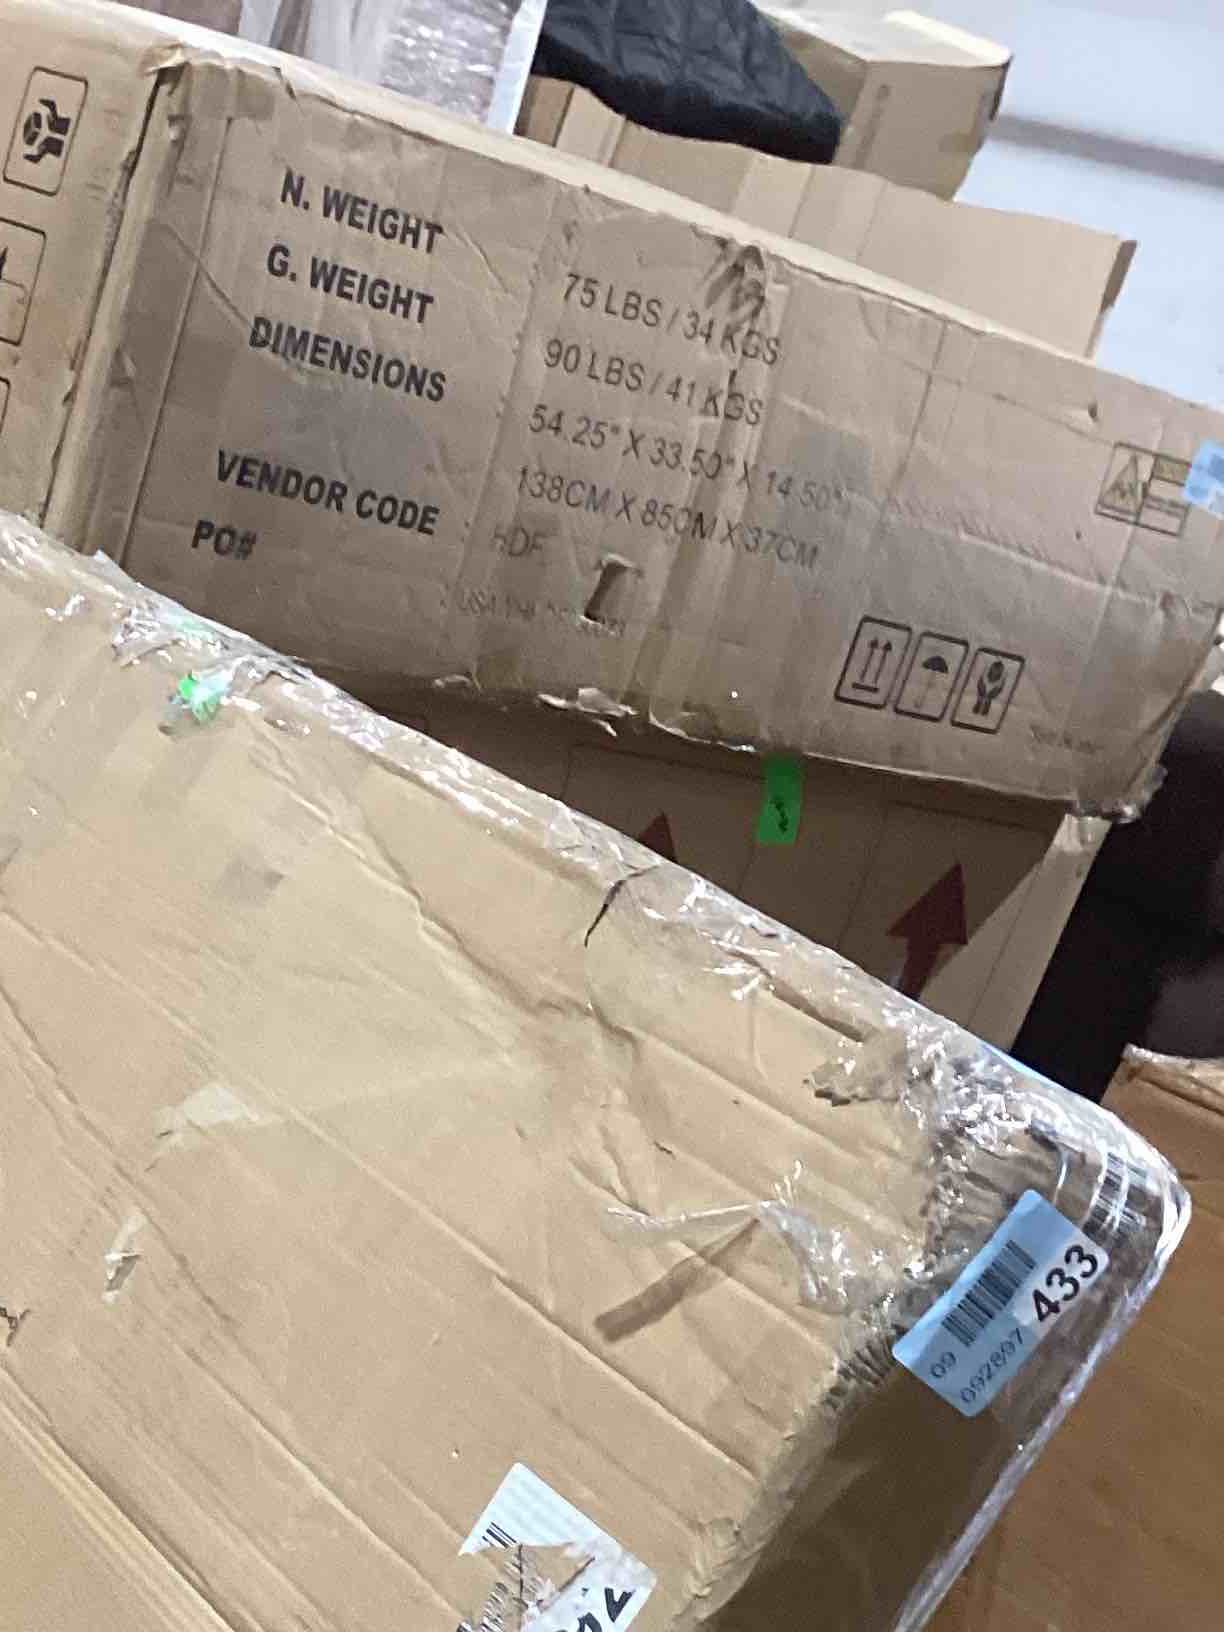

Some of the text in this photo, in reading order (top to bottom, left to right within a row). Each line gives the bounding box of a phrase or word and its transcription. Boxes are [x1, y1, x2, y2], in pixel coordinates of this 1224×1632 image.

[280, 167, 445, 254] N. WEIGHT
[266, 244, 435, 324] G. WEIGHT
[563, 273, 599, 308] 75
[604, 285, 662, 327] LBS
[682, 310, 714, 345] 34
[721, 323, 781, 366] KGS
[247, 316, 447, 403] DIMENSIONS
[543, 337, 580, 374] 90
[587, 351, 645, 392] LBS
[666, 376, 696, 407] 41
[699, 386, 764, 427] KGS
[216, 448, 441, 536] VENDOR CODE
[622, 428, 644, 460] X
[736, 460, 753, 493] X
[190, 518, 258, 561] PO#
[517, 464, 820, 570] 138CM X 85CM X 37CM
[1032, 1244, 1099, 1323] 433
[929, 1350, 958, 1380] 09
